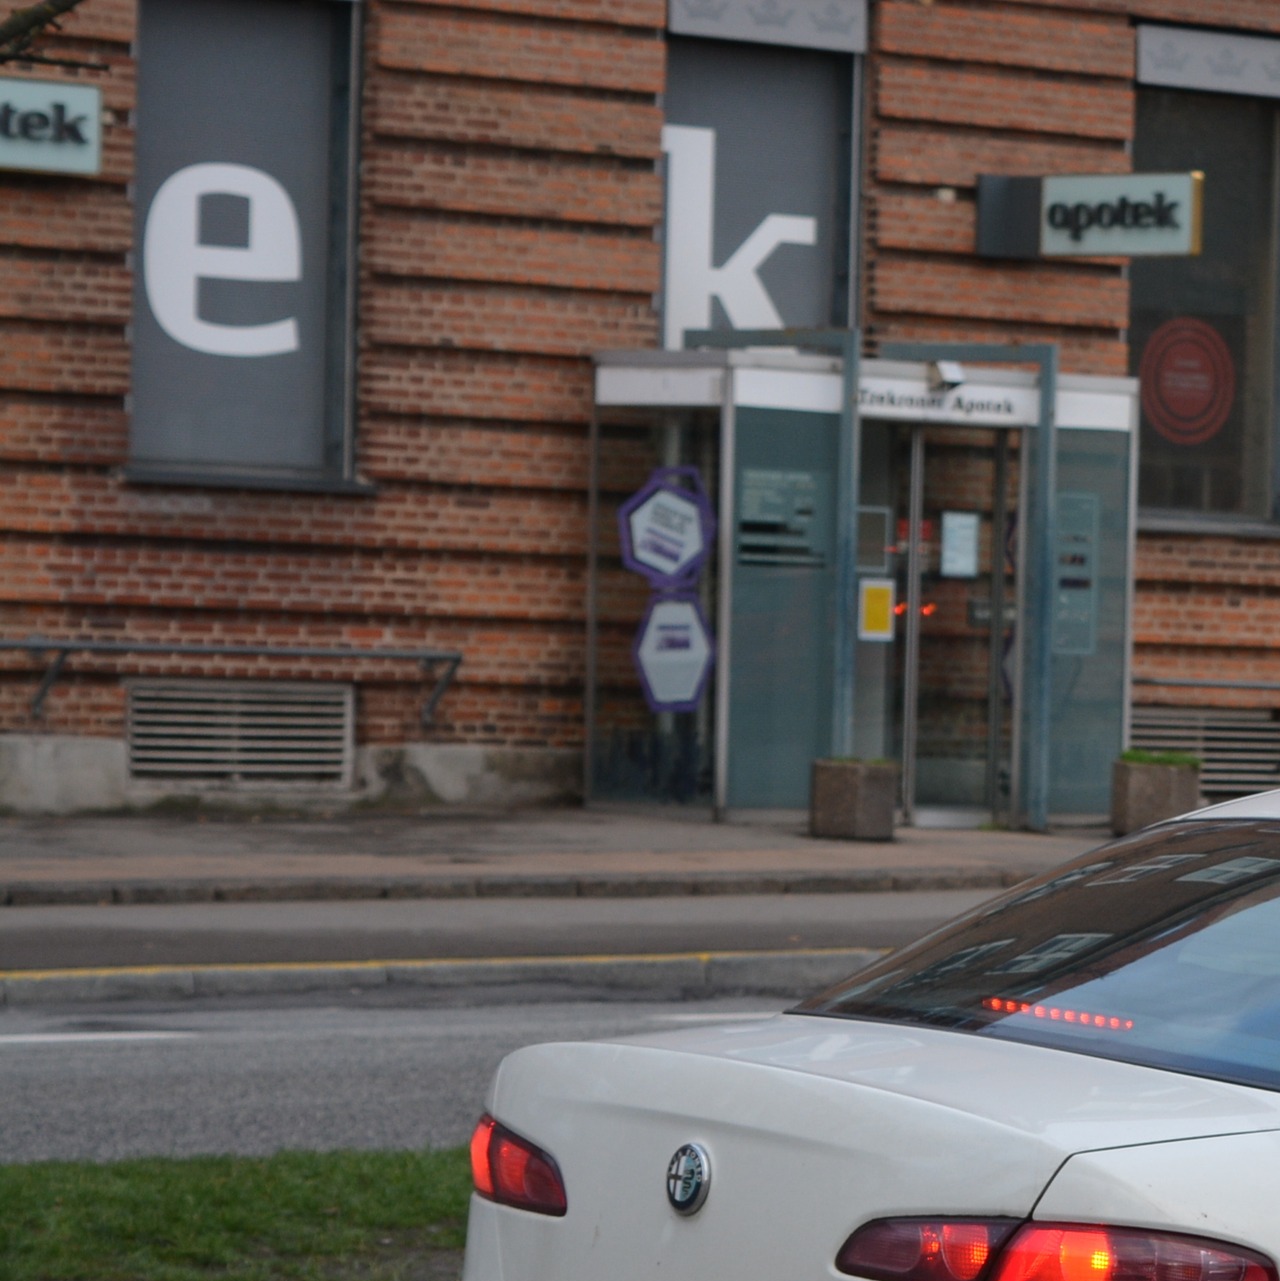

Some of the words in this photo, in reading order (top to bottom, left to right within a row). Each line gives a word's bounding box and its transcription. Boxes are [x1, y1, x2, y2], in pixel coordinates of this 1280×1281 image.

[143, 162, 304, 358] e
[661, 124, 817, 352] k
[1048, 192, 1179, 242] apotek
[951, 396, 1013, 414] Apotek
